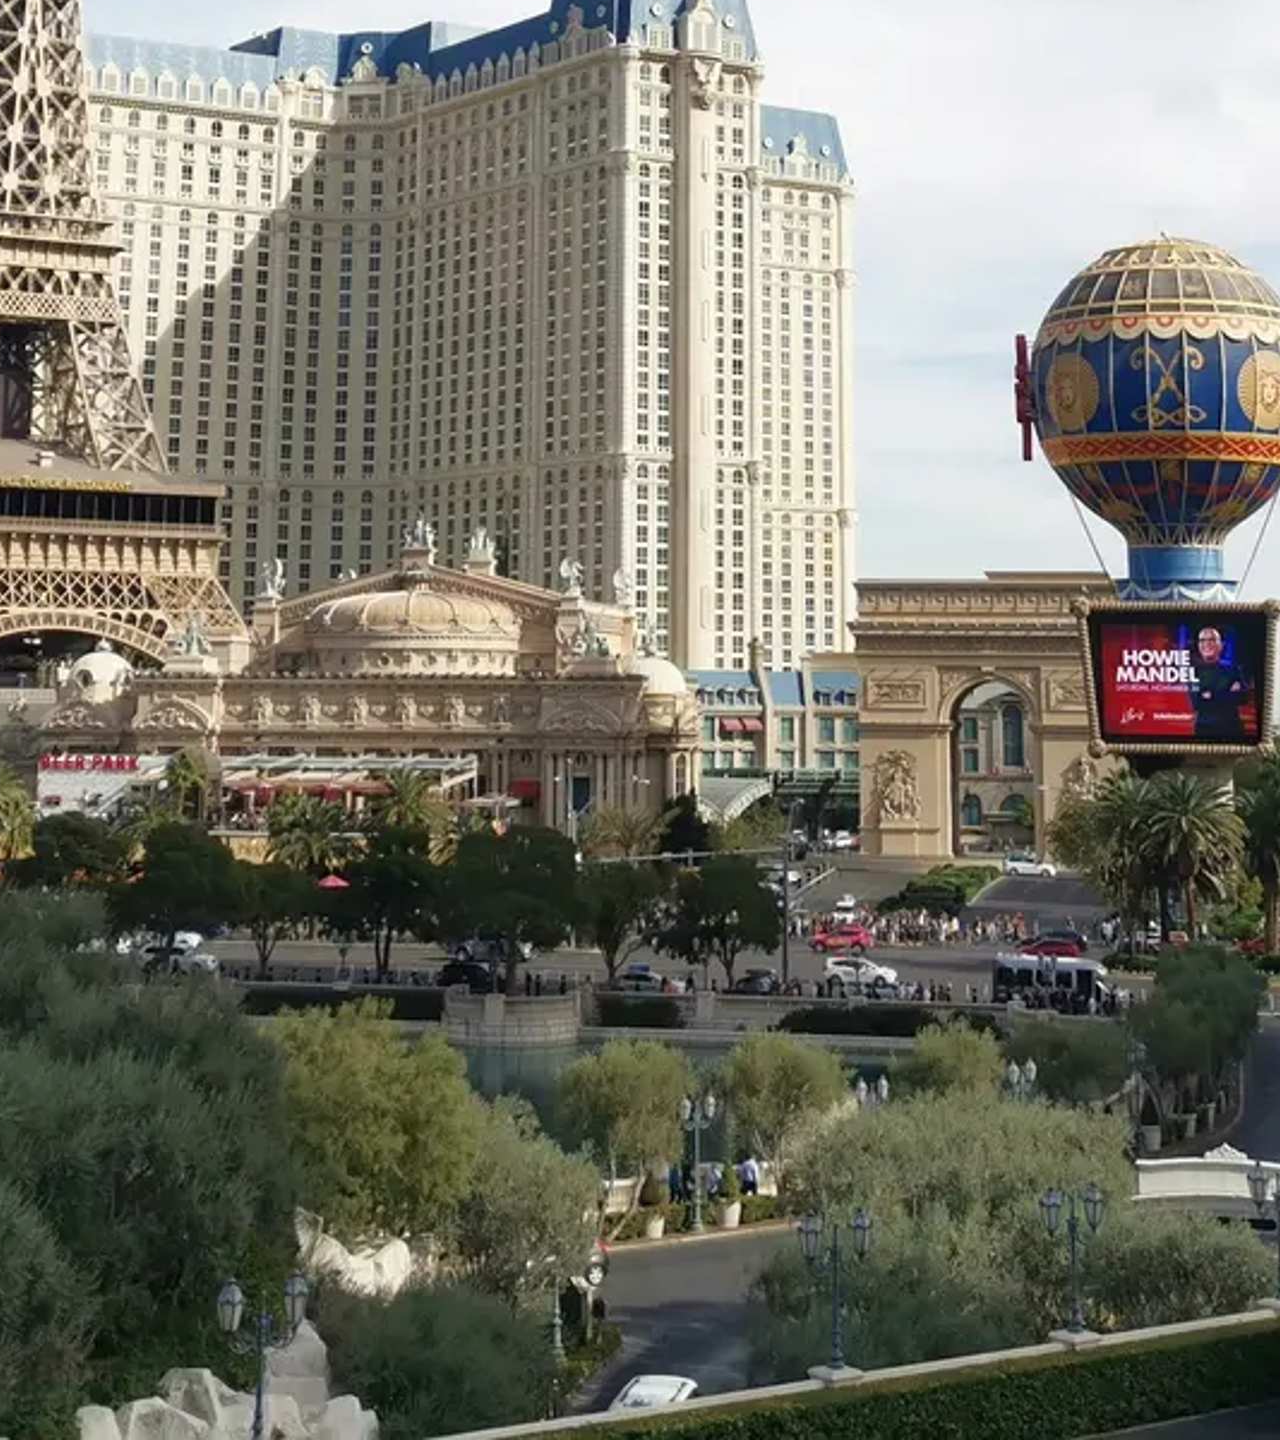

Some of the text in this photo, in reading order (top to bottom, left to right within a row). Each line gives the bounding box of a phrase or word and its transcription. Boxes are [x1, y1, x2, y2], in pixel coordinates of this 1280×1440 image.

[1122, 649, 1191, 666] HOWIE
[1116, 666, 1200, 683] MANDEL
[41, 754, 138, 770] BEER PARK
